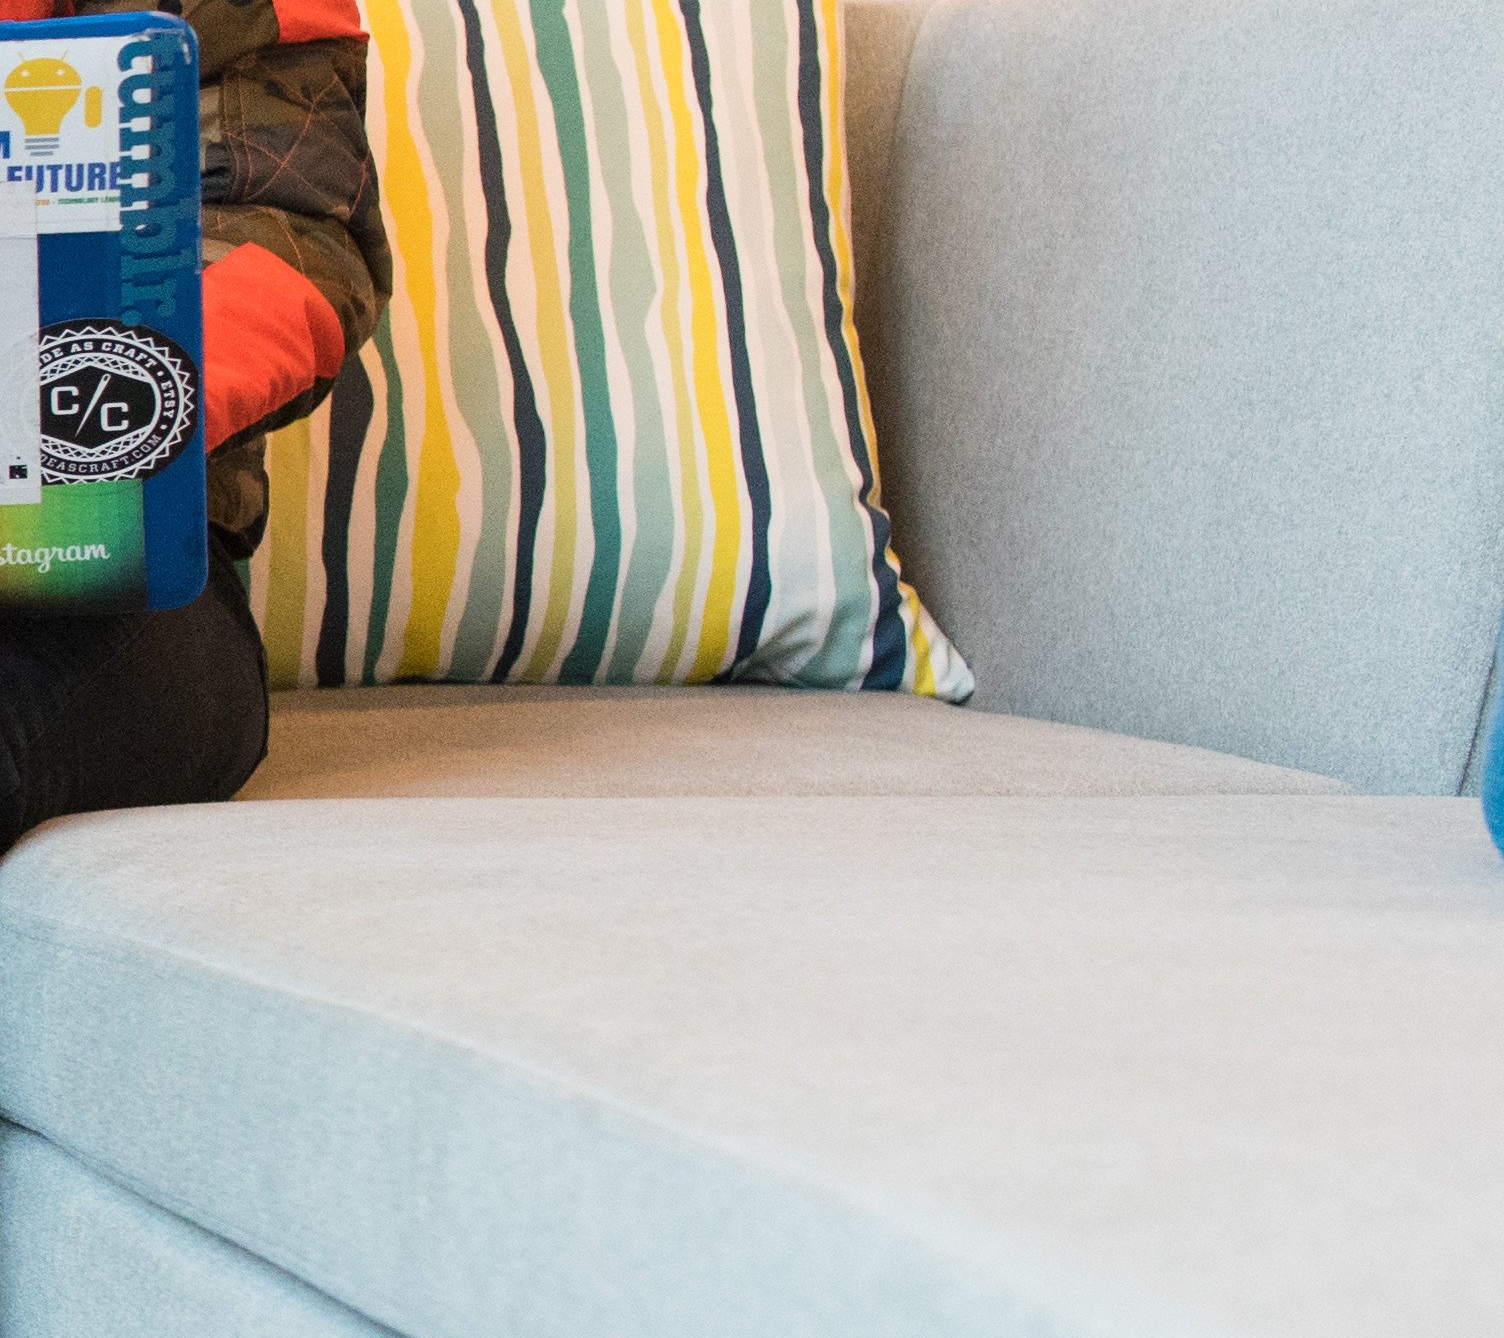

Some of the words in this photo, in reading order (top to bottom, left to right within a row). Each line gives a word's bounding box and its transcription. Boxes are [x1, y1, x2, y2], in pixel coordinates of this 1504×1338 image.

[7, 161, 121, 193] FUTURE
[71, 341, 94, 353] AS
[101, 342, 157, 369] CRAFT
[161, 380, 176, 419] ETSY
